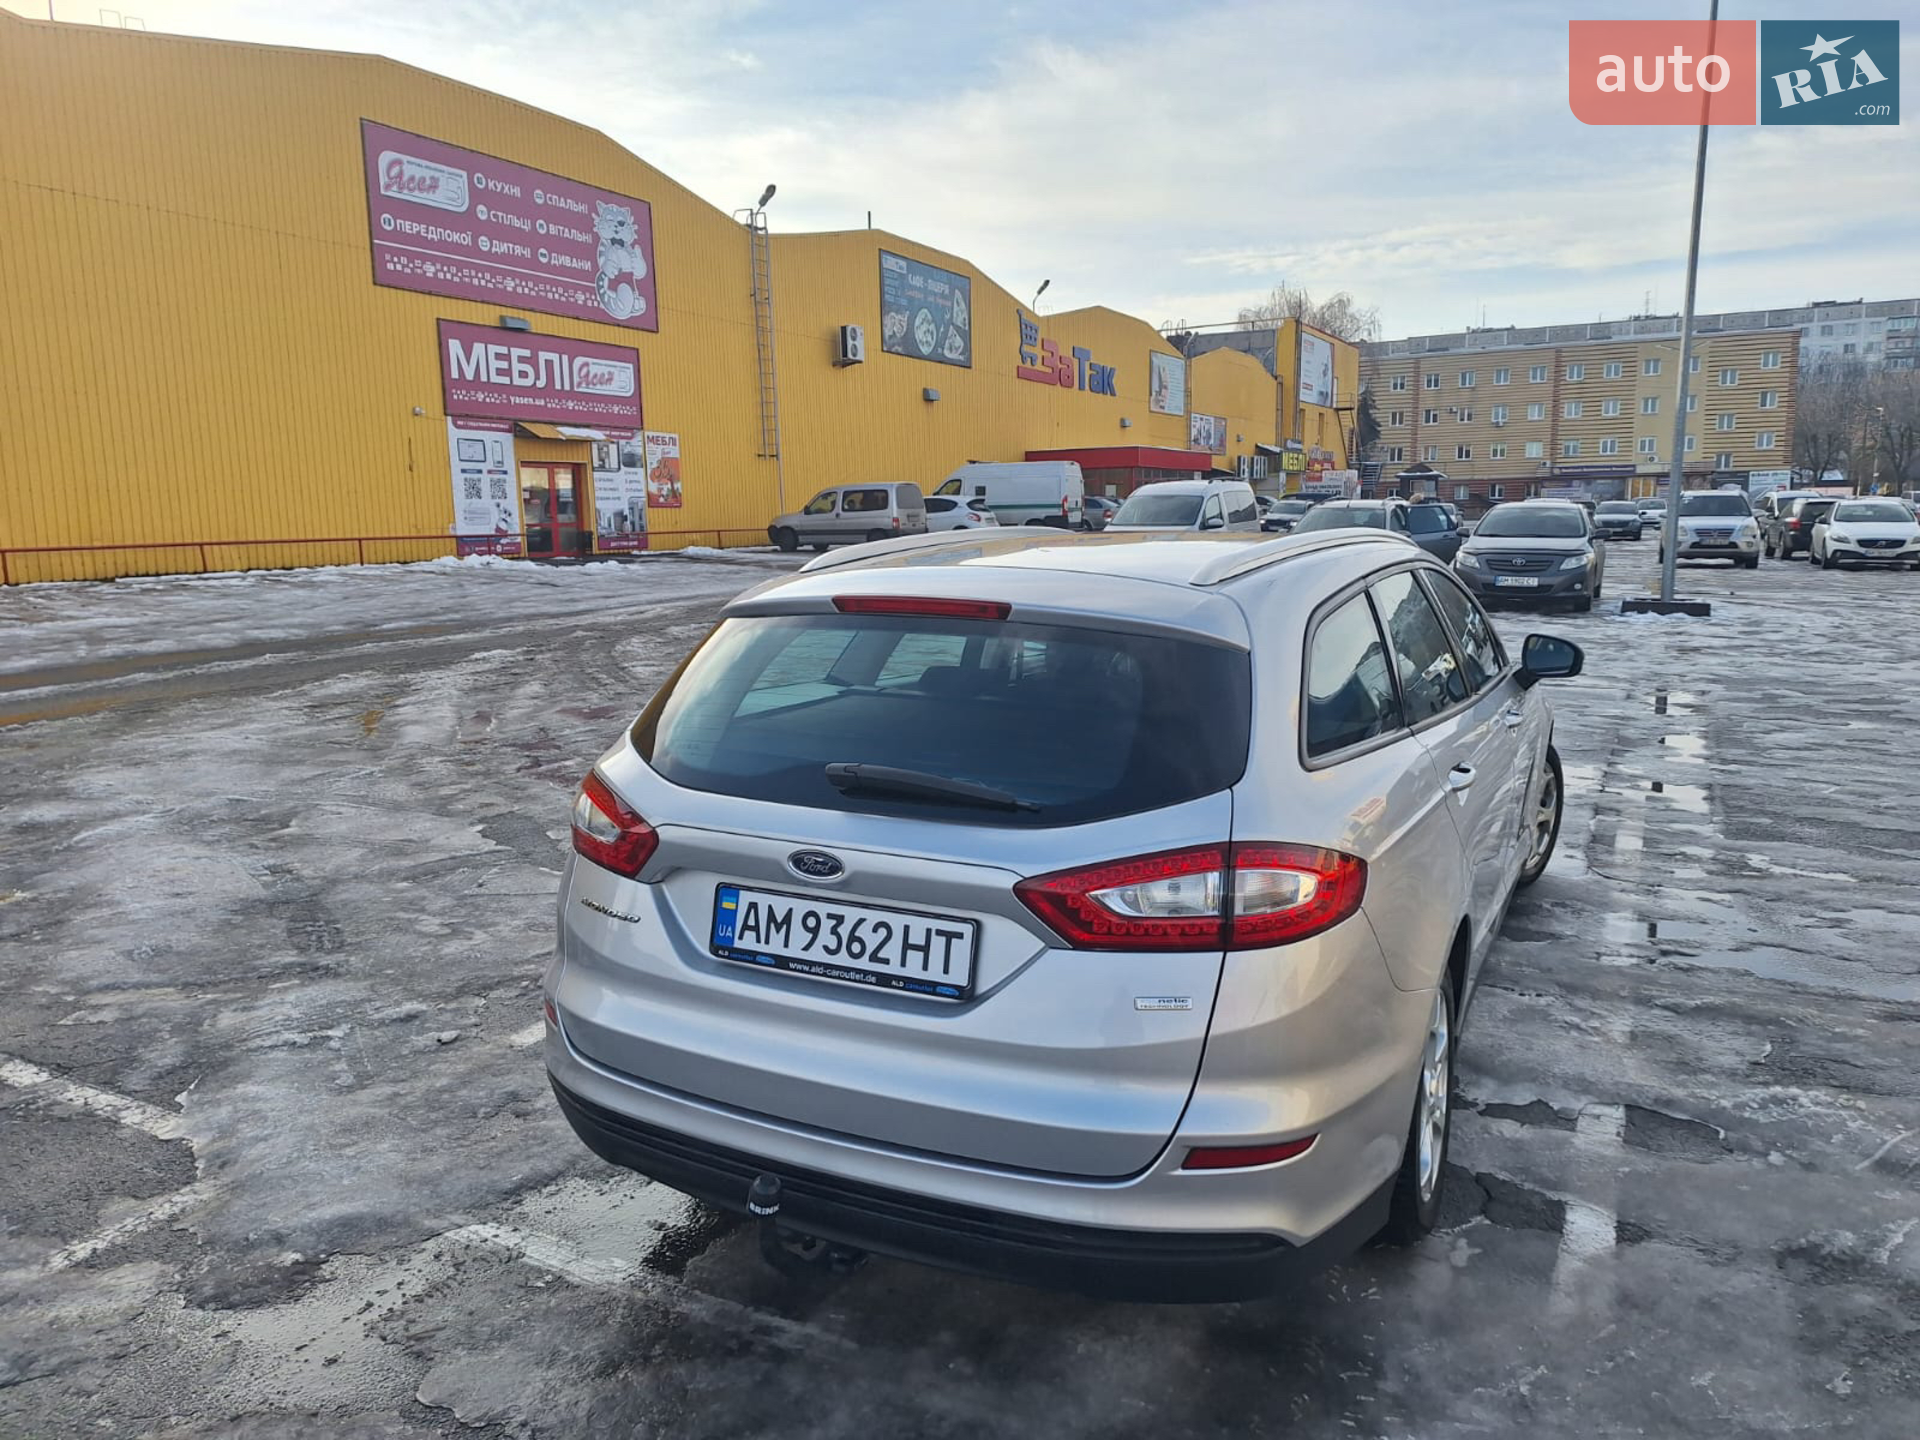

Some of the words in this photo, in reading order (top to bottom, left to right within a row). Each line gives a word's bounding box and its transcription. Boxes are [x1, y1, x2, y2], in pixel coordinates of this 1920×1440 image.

[488, 178, 521, 198] КУХНІ
[546, 193, 588, 215] СПАЛЬНІ
[490, 210, 532, 231] СТІЛЬЦІ
[396, 219, 472, 247] ПЕРЕДПОКОЇ
[548, 223, 593, 244] ВІТАЛЬНІ
[491, 240, 532, 259] ДИТЯЧІ
[550, 253, 592, 272] ДИВАНИ
[448, 339, 571, 391] МЕБЛІ
[510, 395, 545, 407] yasen.ua
[646, 435, 677, 447] МЕБЛІ
[801, 855, 830, 873] Ford
[718, 925, 733, 938] UA
[738, 902, 793, 949] AM
[801, 910, 893, 965] 9362
[900, 924, 964, 975] HT
[789, 961, 877, 984] www.ald-caroutlet.de
[892, 980, 904, 988] ALD
